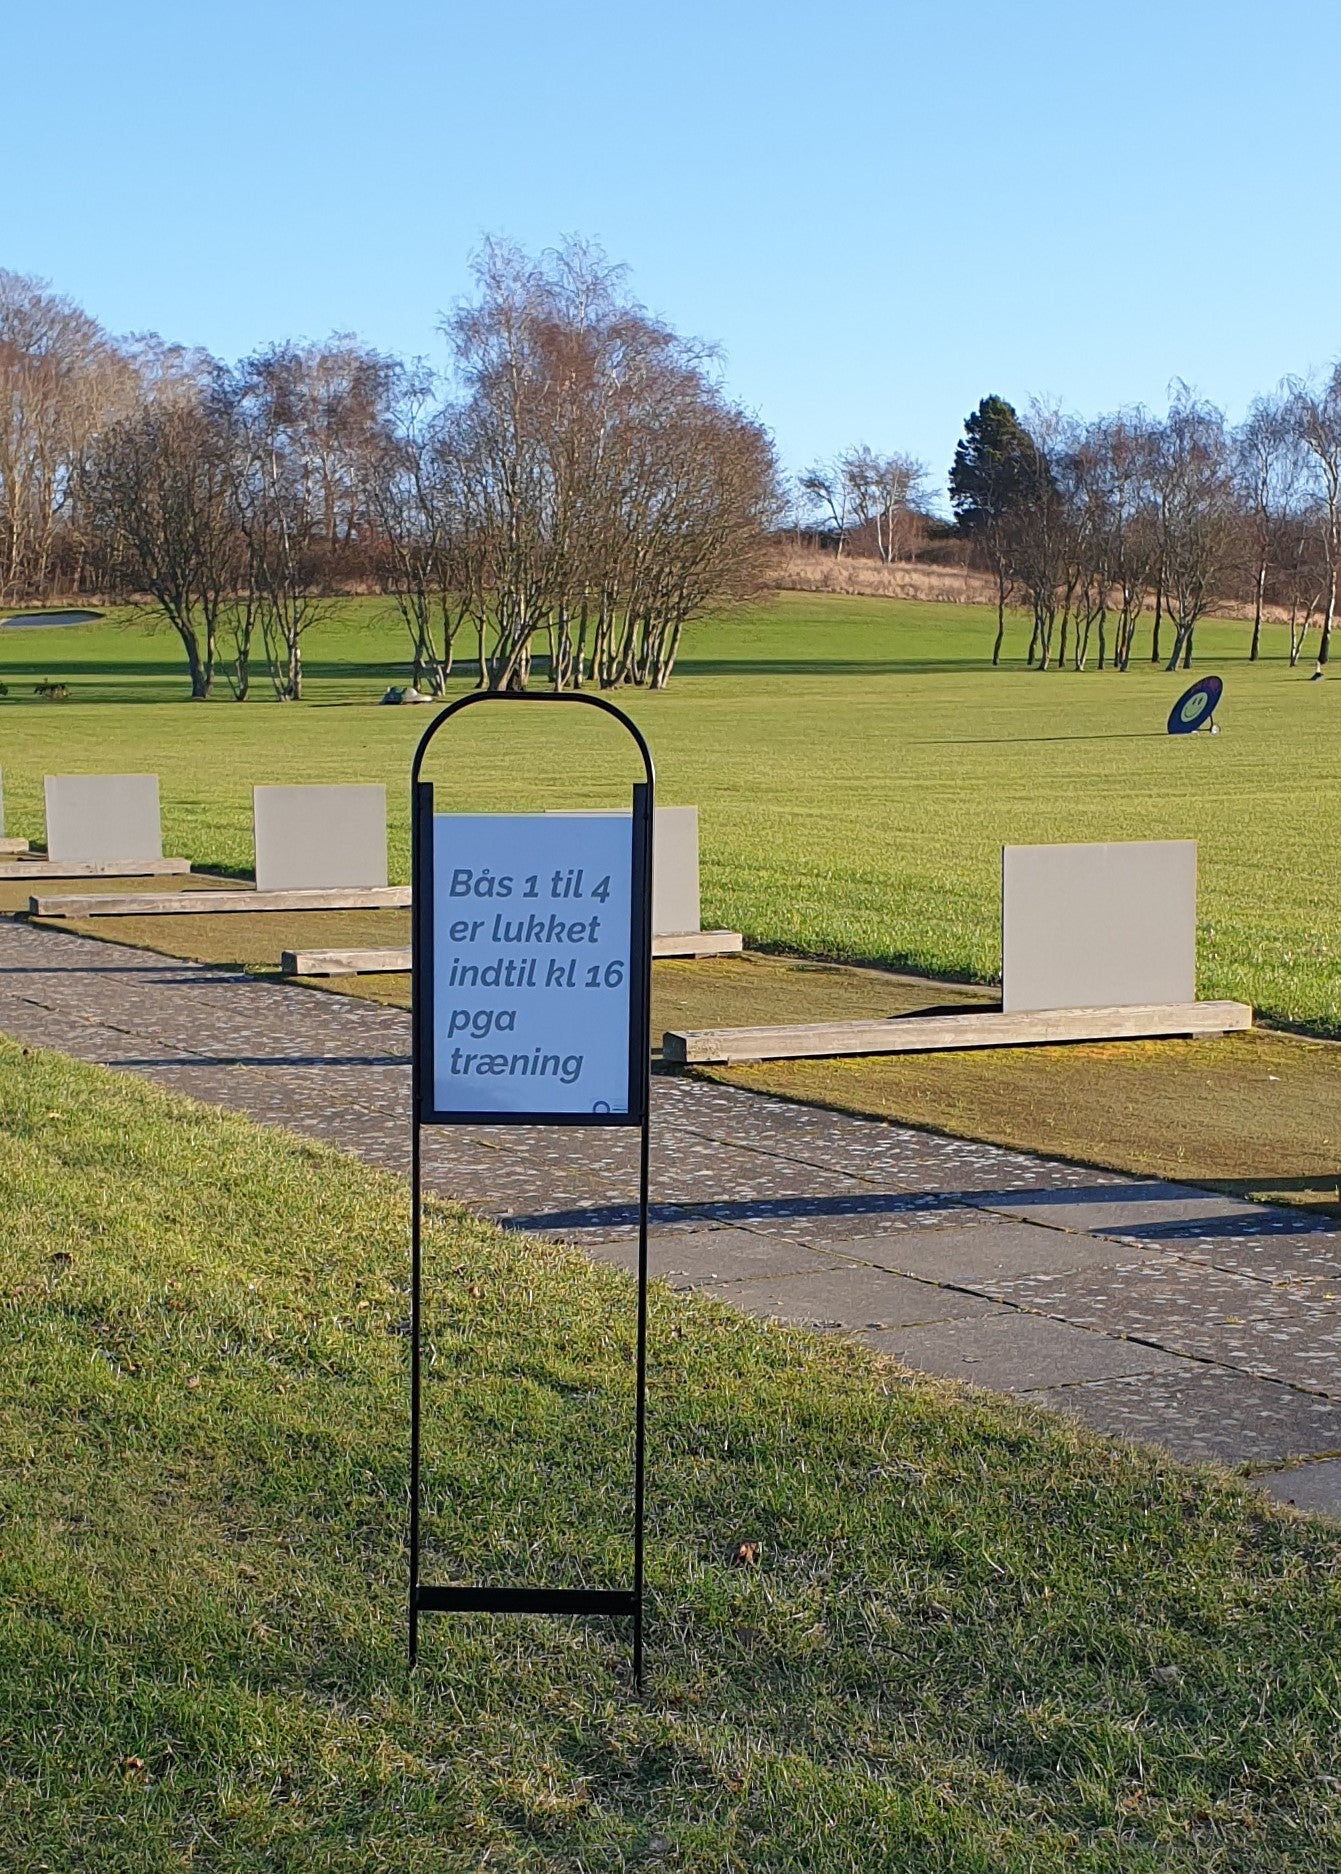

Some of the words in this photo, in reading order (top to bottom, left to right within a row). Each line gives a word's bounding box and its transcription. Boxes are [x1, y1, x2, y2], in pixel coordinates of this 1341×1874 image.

[449, 869, 514, 897] Bås
[523, 875, 538, 897] 1
[551, 869, 583, 898] til
[591, 876, 610, 903] 4
[450, 921, 485, 942] er
[492, 914, 600, 943] lukket
[449, 958, 537, 987] indtil
[545, 959, 576, 987] kl
[585, 960, 624, 988] 16
[447, 1010, 516, 1039] pga
[451, 1047, 583, 1084] træning
